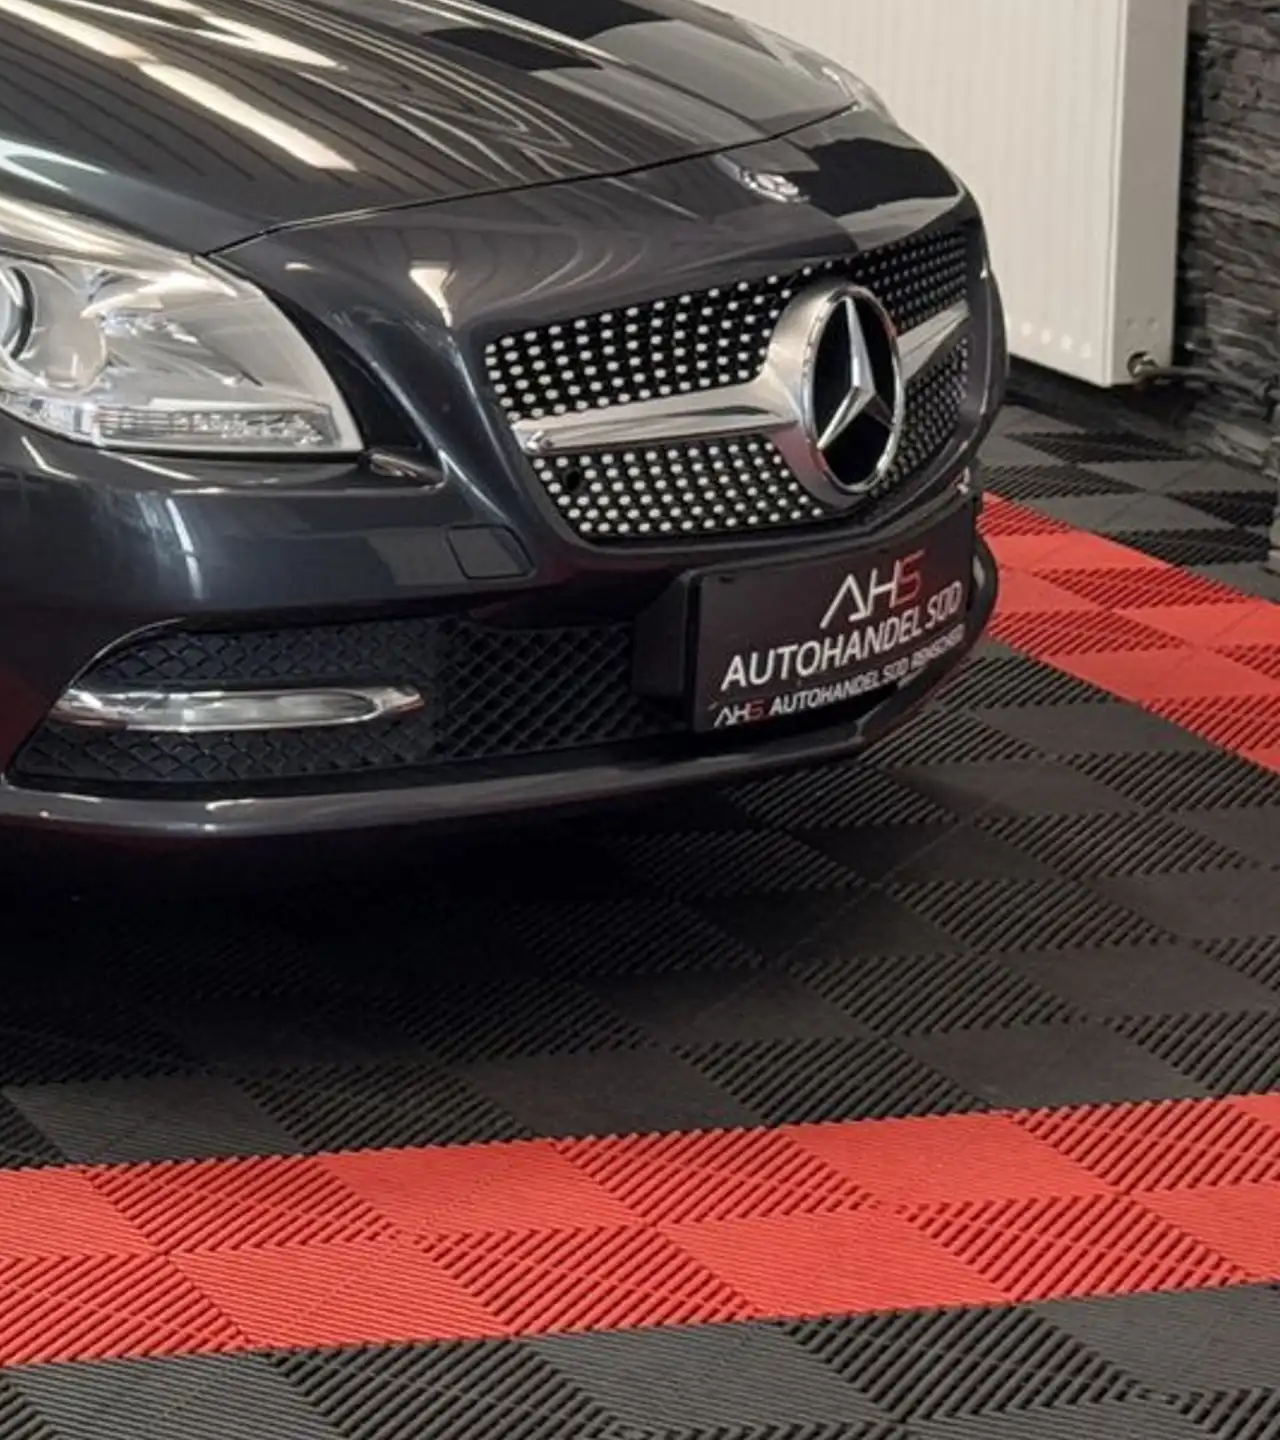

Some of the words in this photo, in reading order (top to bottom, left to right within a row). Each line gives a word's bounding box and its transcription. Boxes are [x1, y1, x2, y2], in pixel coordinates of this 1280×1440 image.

[820, 548, 925, 629] AHS
[720, 605, 923, 692] AUTOHANDEL
[768, 669, 881, 717] AUTOHANDEL
